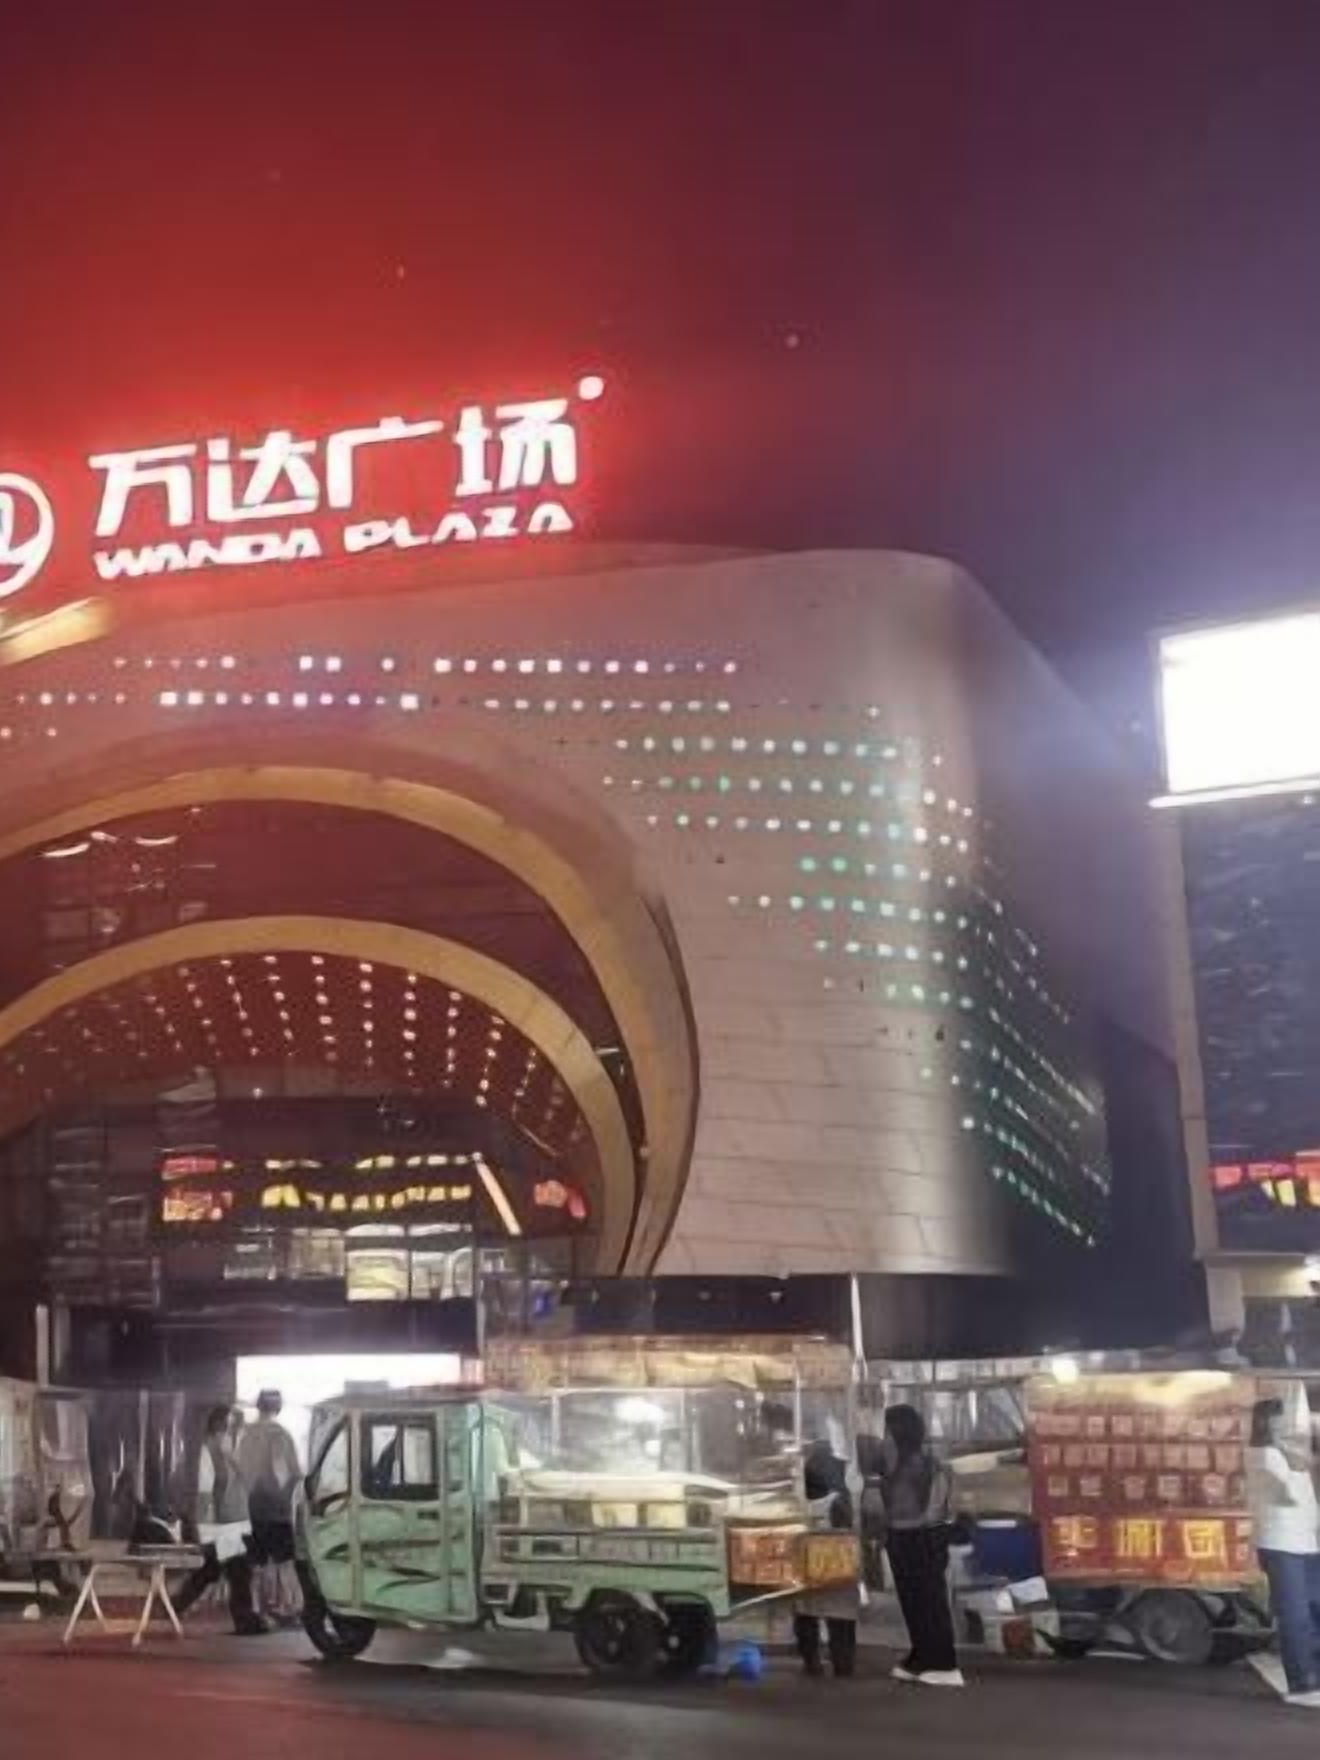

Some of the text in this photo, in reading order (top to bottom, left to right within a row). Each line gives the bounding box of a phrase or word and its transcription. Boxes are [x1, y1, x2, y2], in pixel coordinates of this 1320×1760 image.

[88, 398, 578, 536] 万达广场
[94, 502, 574, 579] WANDA PLAZA
